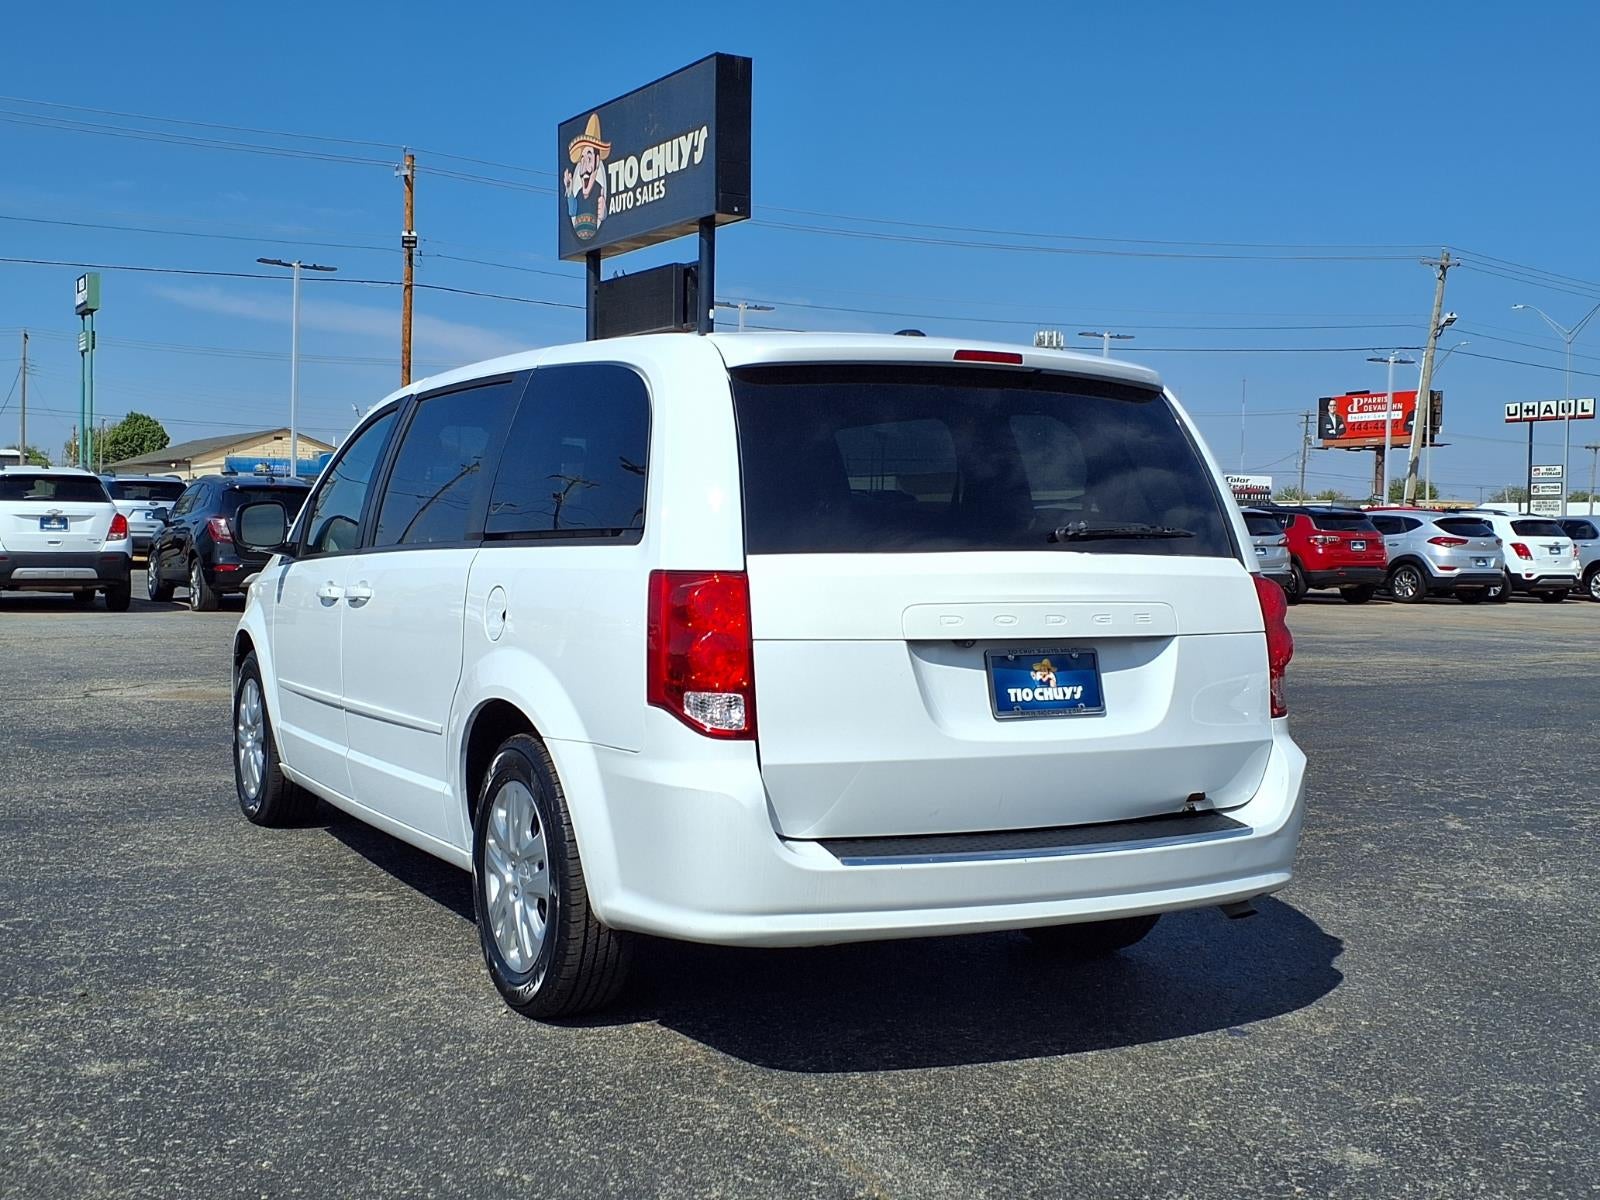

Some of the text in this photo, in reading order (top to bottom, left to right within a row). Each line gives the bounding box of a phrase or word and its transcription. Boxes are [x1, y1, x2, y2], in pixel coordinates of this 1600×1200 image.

[608, 125, 708, 194] TIO CHUY'S
[609, 179, 665, 214] AUTO SALES
[1363, 403, 1402, 411] DEVAUHN
[1350, 421, 1398, 430] 444-444
[939, 614, 1153, 626] DODGE
[1007, 685, 1083, 702] TIO CHUY'S
